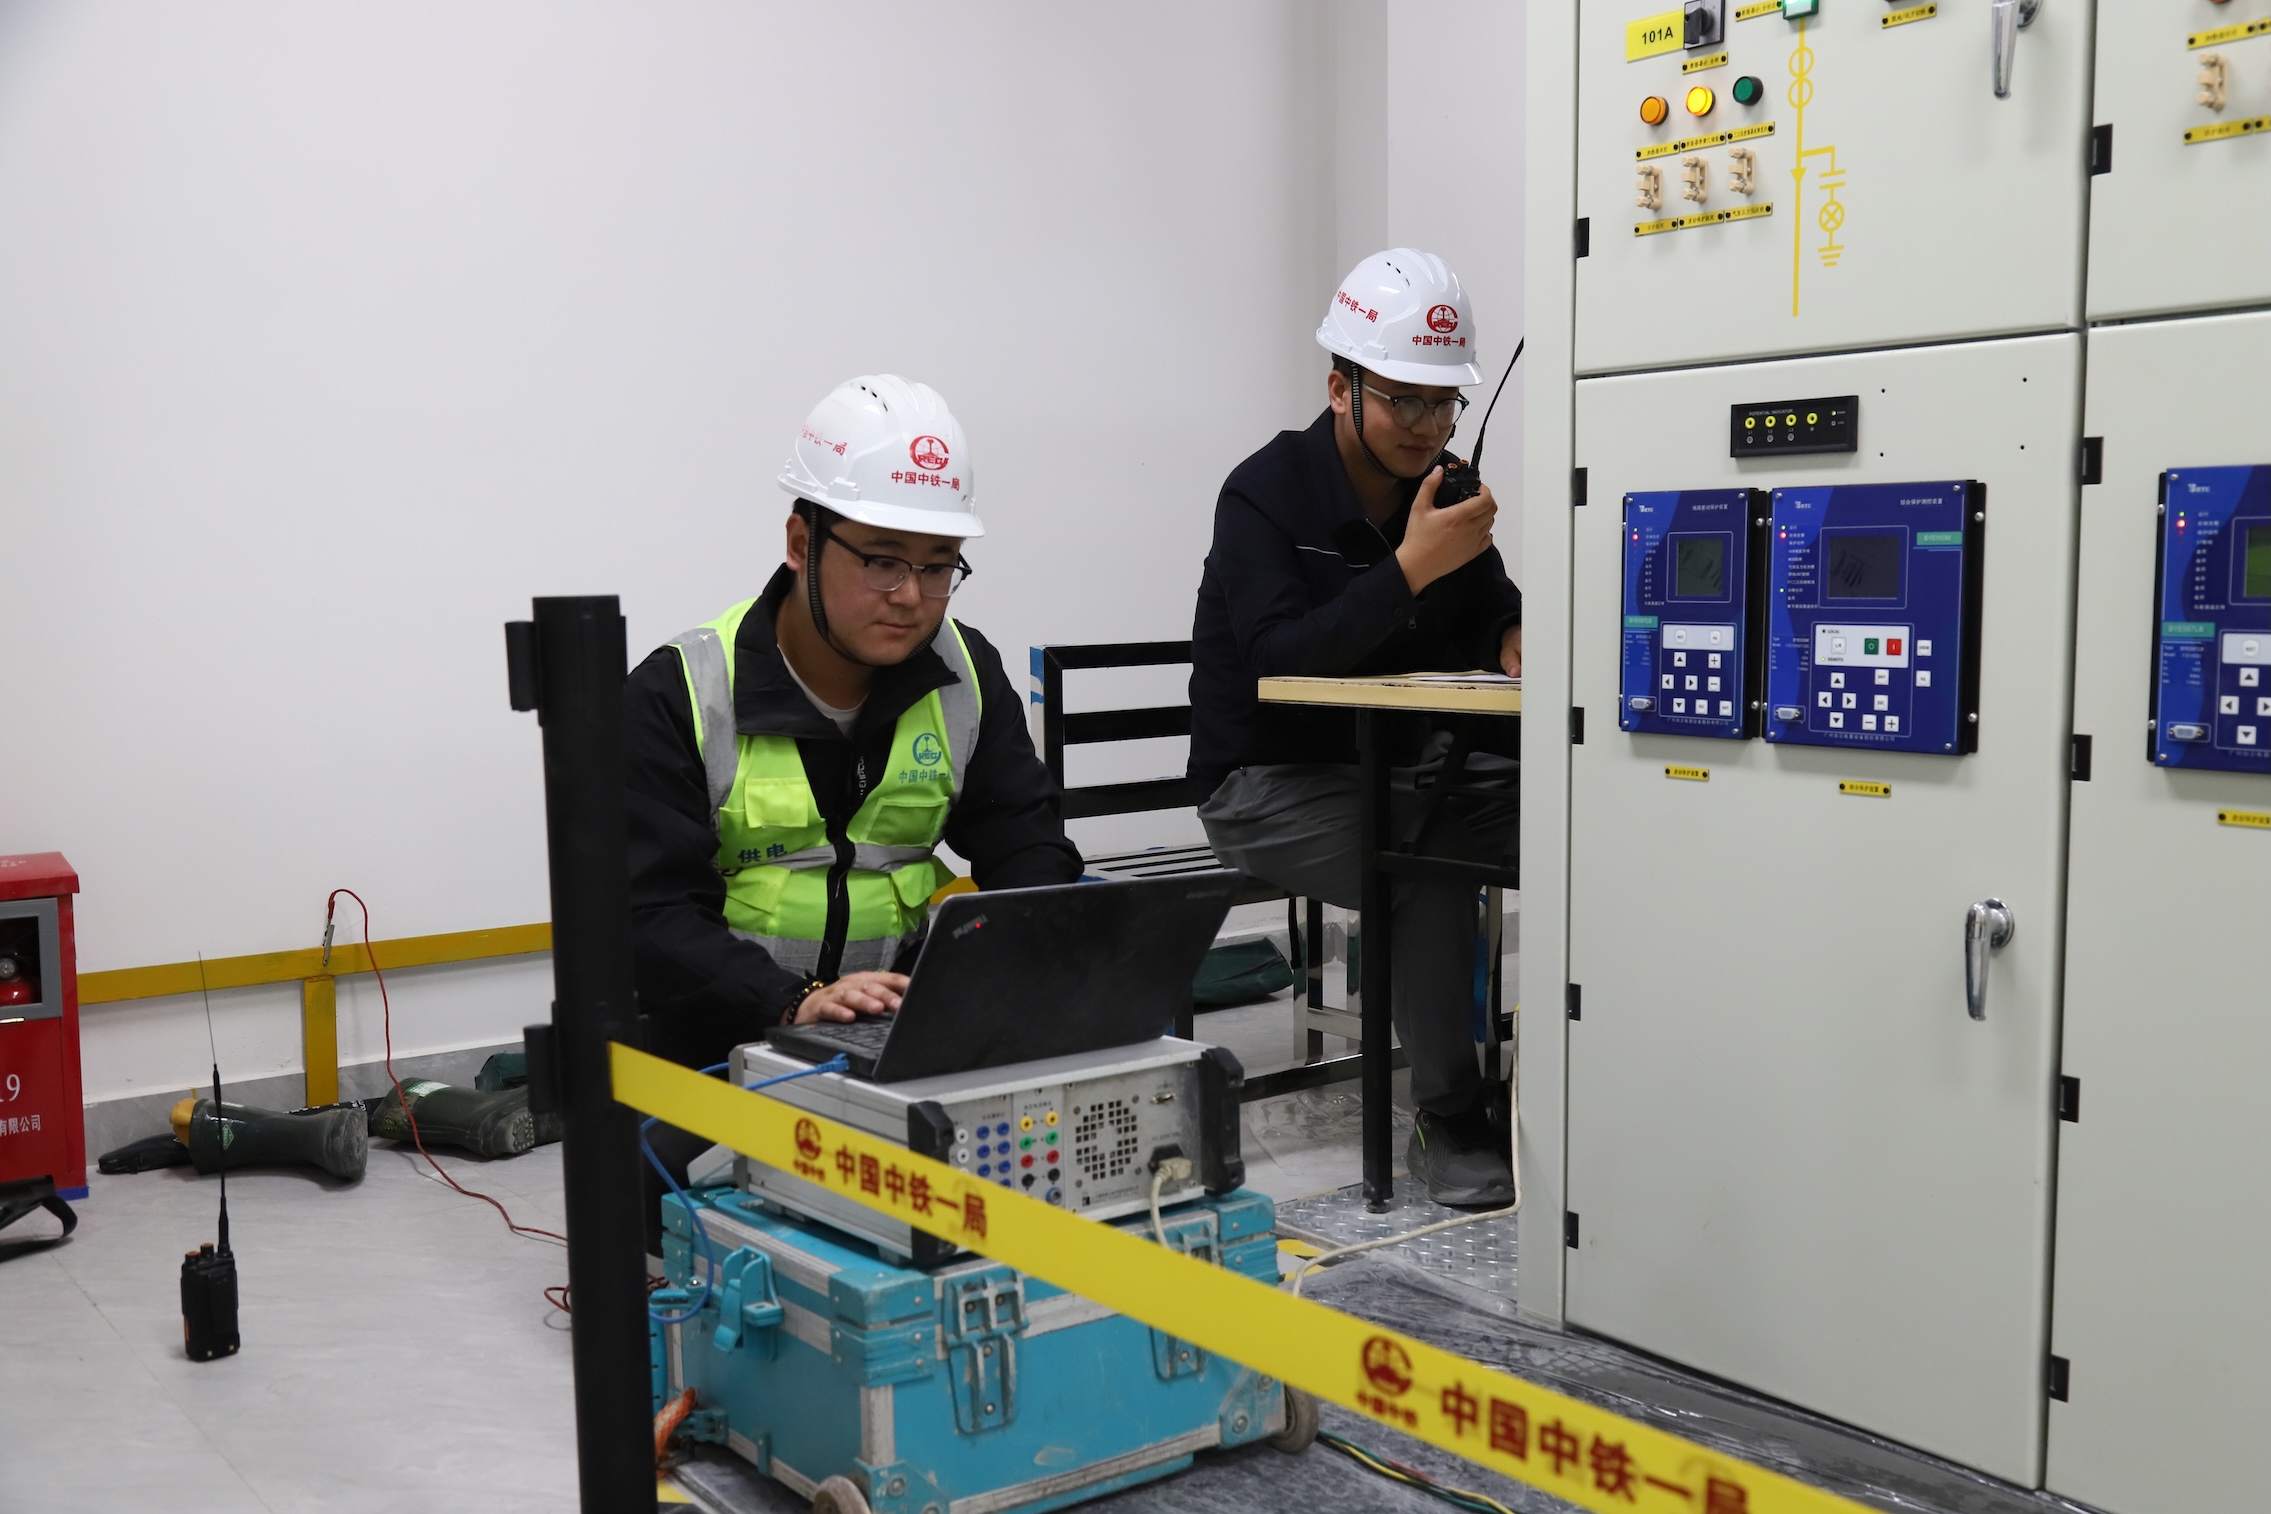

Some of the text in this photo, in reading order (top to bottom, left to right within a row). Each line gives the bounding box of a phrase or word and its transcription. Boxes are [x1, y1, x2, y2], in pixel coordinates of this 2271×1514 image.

[1641, 26, 1674, 45] 101A
[1412, 335, 1466, 348] 中国中铁一局
[891, 470, 960, 491] 中国中铁一局
[737, 843, 788, 864] 供电
[0, 1073, 21, 1103] 9
[835, 1144, 988, 1241] 中国中铁一局
[1440, 1380, 1749, 1514] 中国中铁一局
